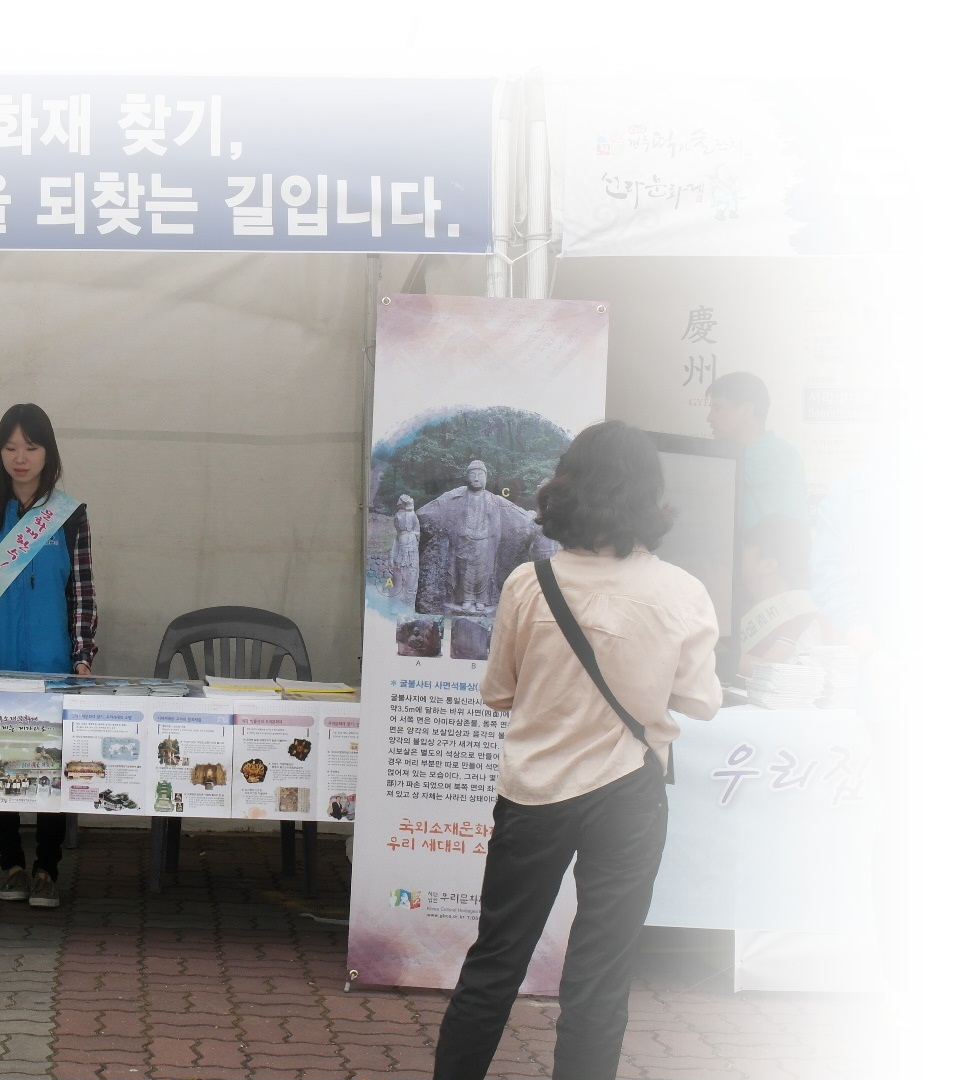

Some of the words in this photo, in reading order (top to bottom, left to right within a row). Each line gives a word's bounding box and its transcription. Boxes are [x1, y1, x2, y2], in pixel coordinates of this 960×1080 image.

[117, 94, 242, 160] 찾기,
[37, 172, 198, 236] 되찾는
[225, 173, 460, 238] 길입니다.
[681, 305, 718, 387] 慶州
[501, 487, 510, 498] C
[385, 576, 395, 588] A
[415, 659, 422, 667] A
[429, 695, 443, 704] 있는
[386, 836, 414, 851] 우리
[421, 838, 465, 854] 세대의
[440, 892, 481, 906] 우리문화
